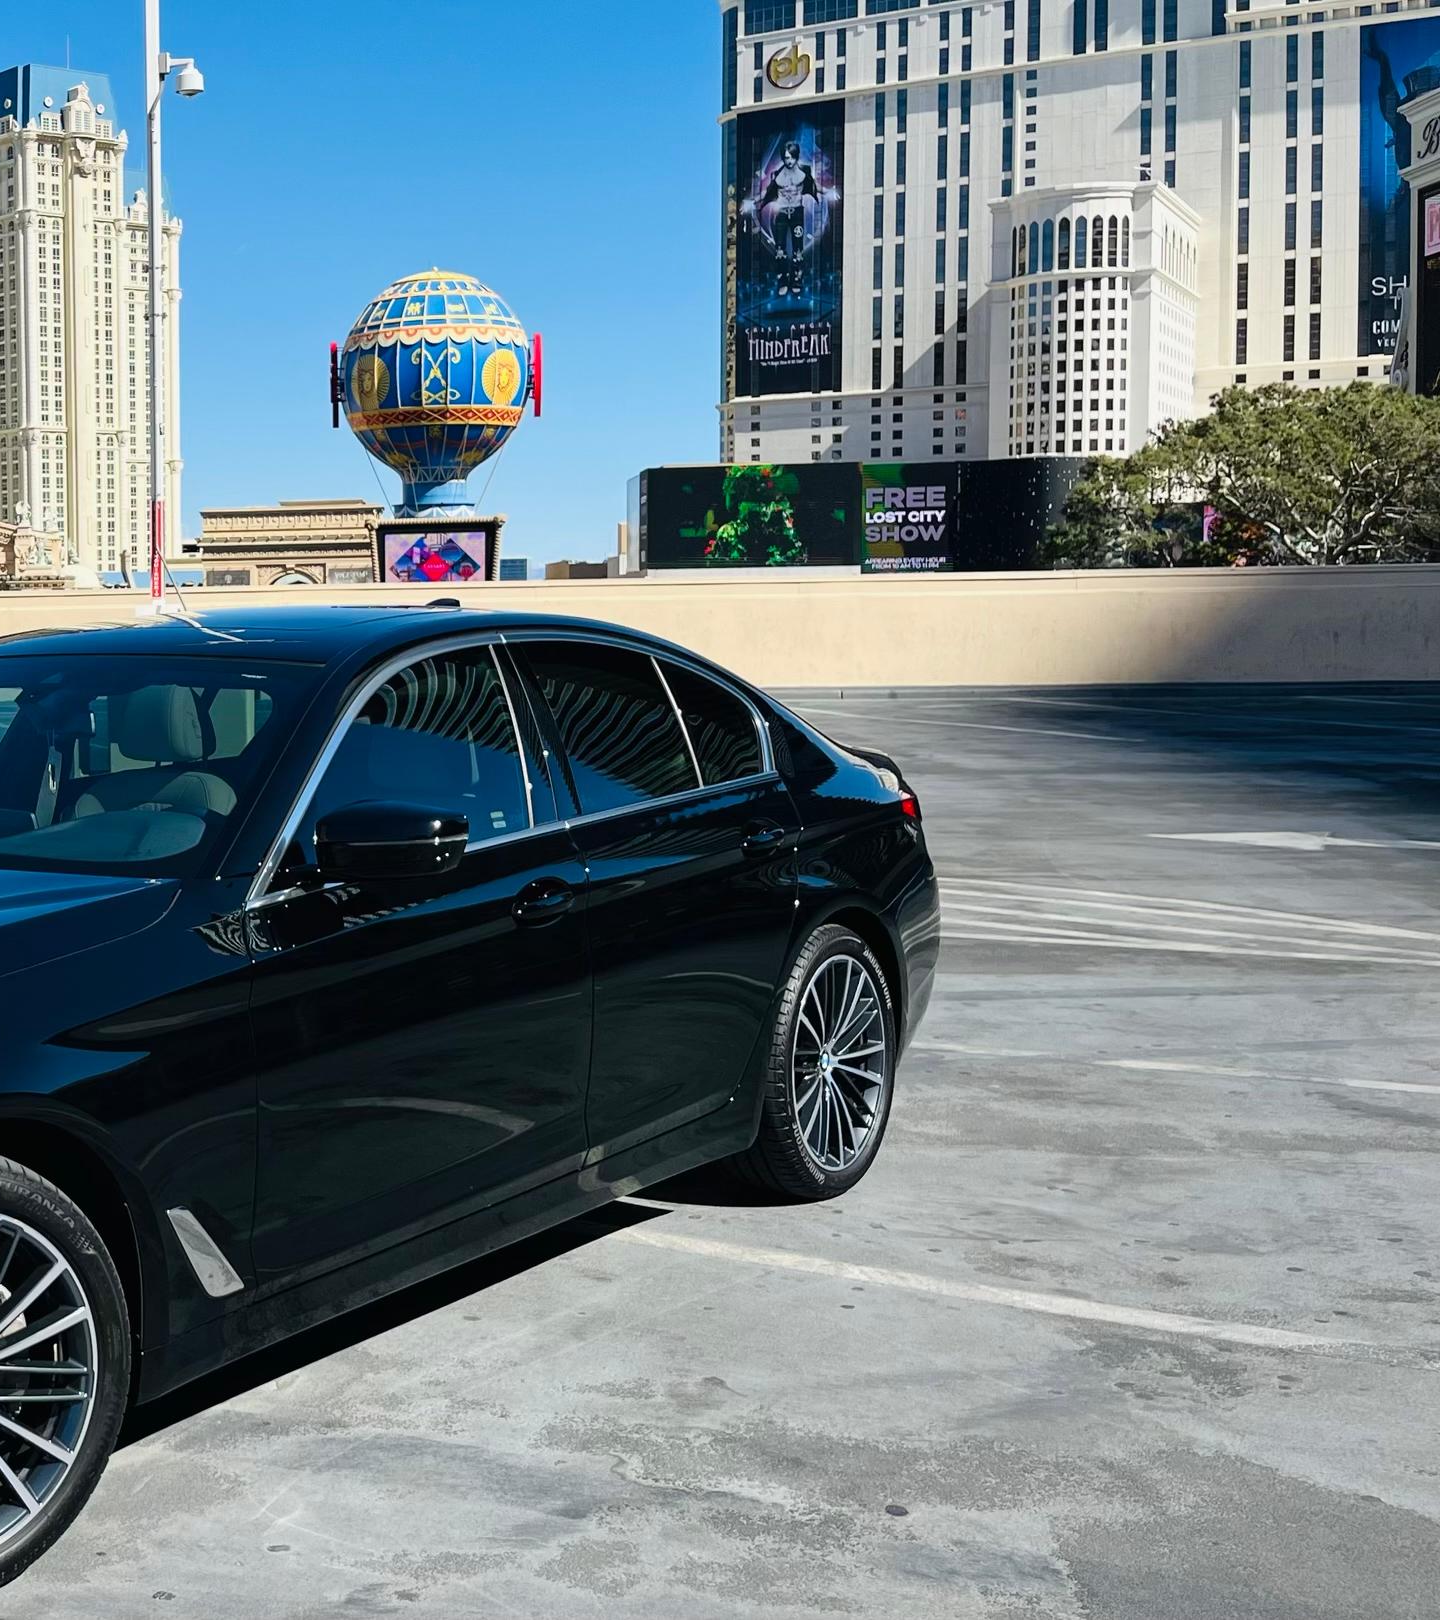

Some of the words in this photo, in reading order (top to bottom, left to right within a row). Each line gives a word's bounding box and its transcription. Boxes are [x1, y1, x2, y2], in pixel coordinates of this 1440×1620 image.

[865, 486, 946, 508] FREE
[865, 511, 906, 524] LOST
[907, 510, 946, 523] CITY
[865, 525, 946, 542] SHOW
